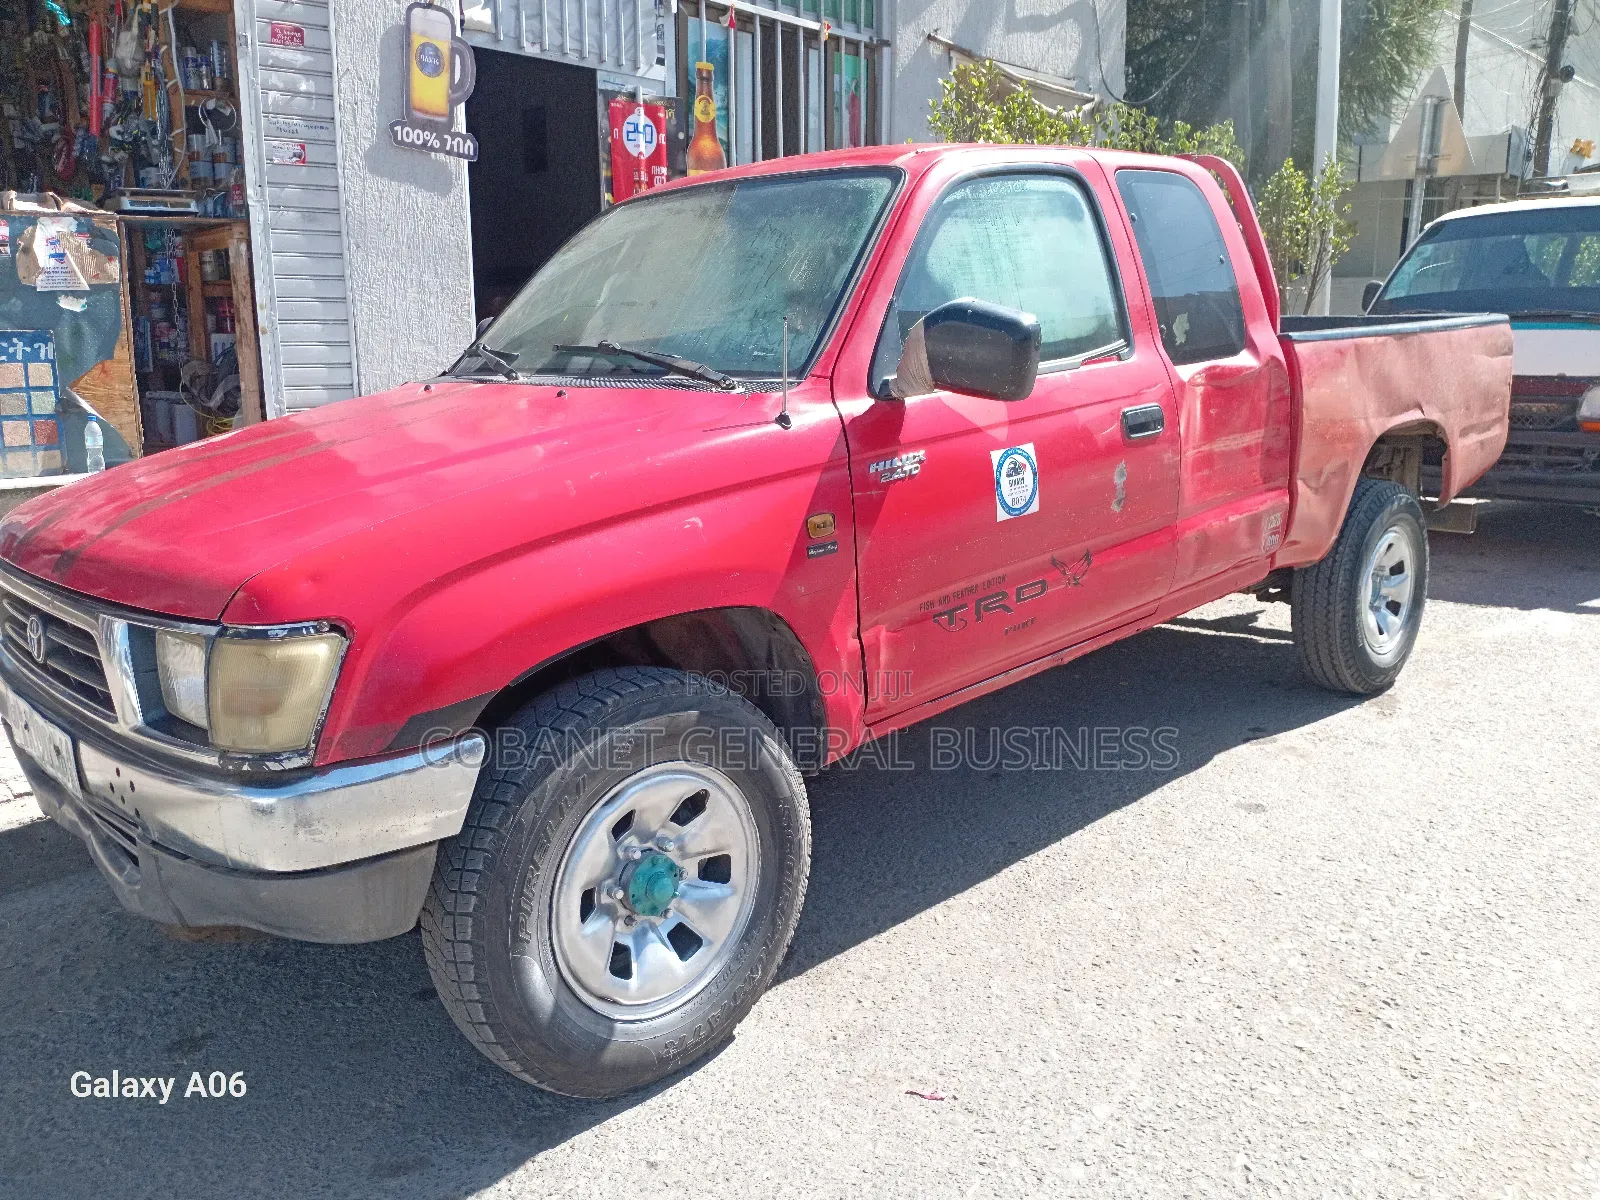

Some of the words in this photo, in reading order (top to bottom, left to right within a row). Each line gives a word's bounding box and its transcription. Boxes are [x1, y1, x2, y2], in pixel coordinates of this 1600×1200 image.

[393, 125, 441, 149] 100%
[919, 601, 935, 613] FISH
[938, 595, 951, 607] AND
[953, 583, 979, 601] FEATHER
[982, 573, 1008, 590] EDITION
[932, 578, 1049, 628] TRD
[516, 772, 589, 945] PIRELLI
